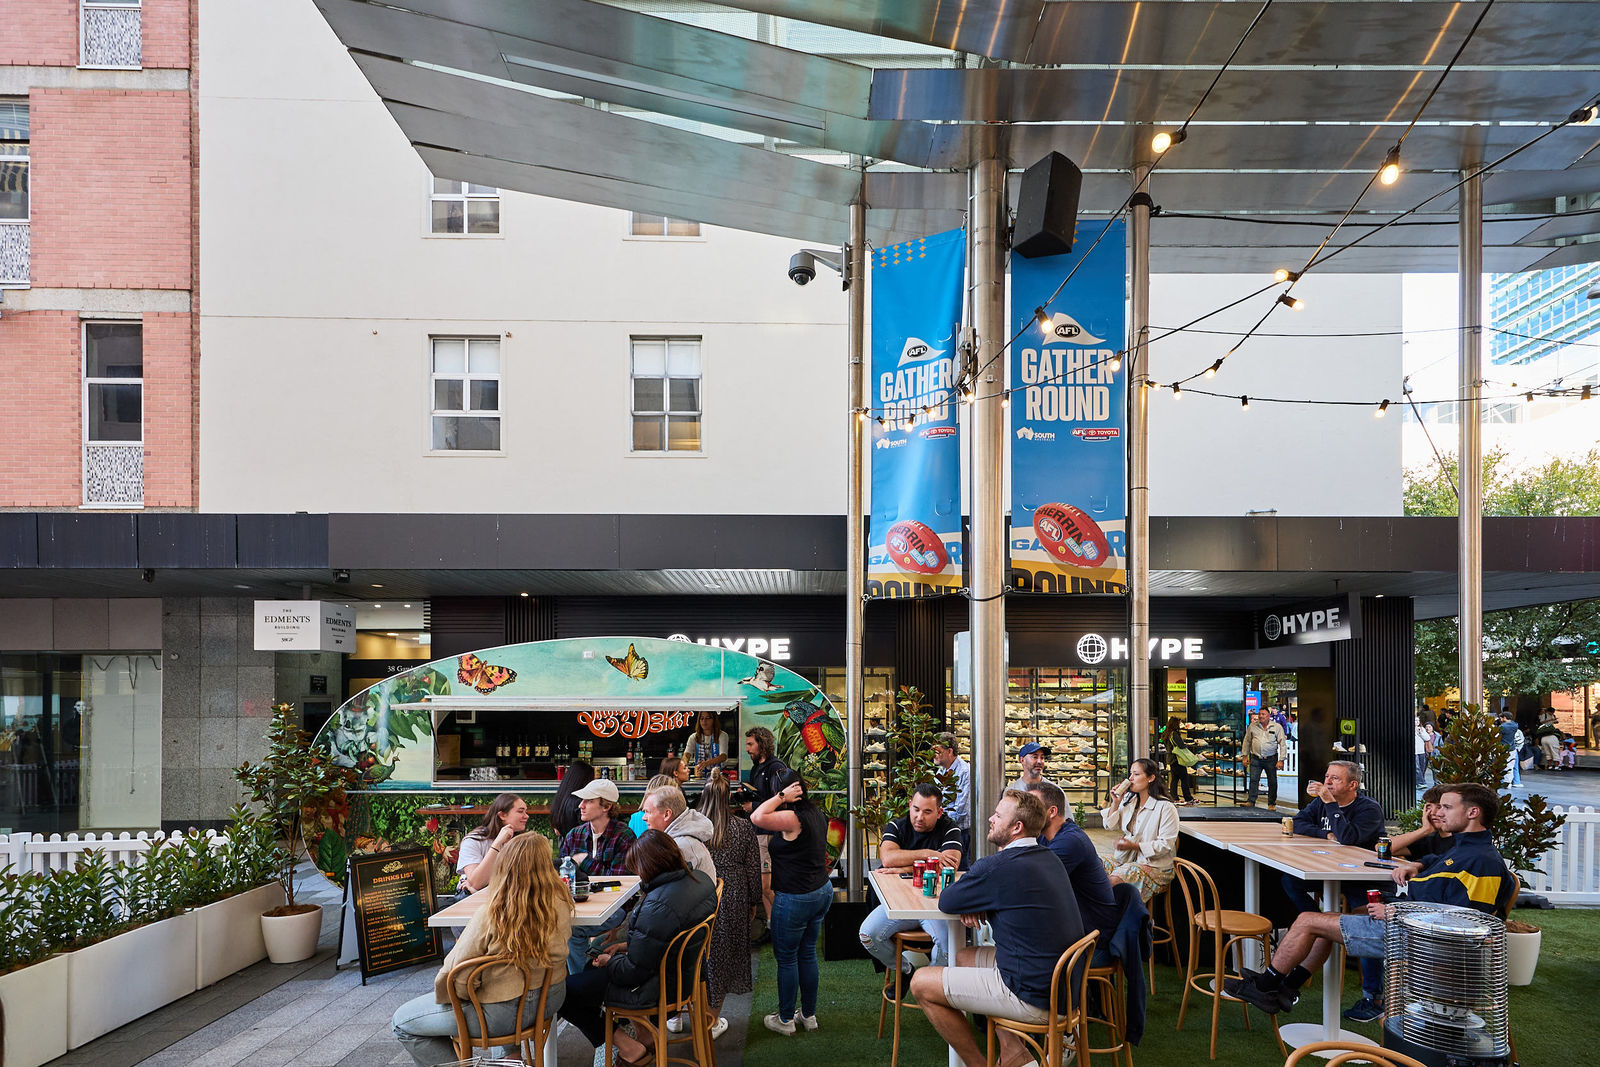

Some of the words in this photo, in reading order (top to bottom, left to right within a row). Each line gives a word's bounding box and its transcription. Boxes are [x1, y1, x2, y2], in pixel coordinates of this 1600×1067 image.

[1056, 326, 1079, 336] AFL
[908, 346, 927, 357] AFL
[1021, 348, 1114, 384] GATHER
[880, 358, 952, 402] GATHER
[883, 390, 949, 432] ROUND
[1025, 385, 1110, 421] ROUND
[1040, 520, 1060, 541] AFL
[264, 615, 311, 623] EDMENTS
[325, 617, 351, 628] EDMENTS
[1282, 607, 1340, 635] HYPE
[387, 665, 396, 673] 38
[372, 874, 400, 884] DRINKS
